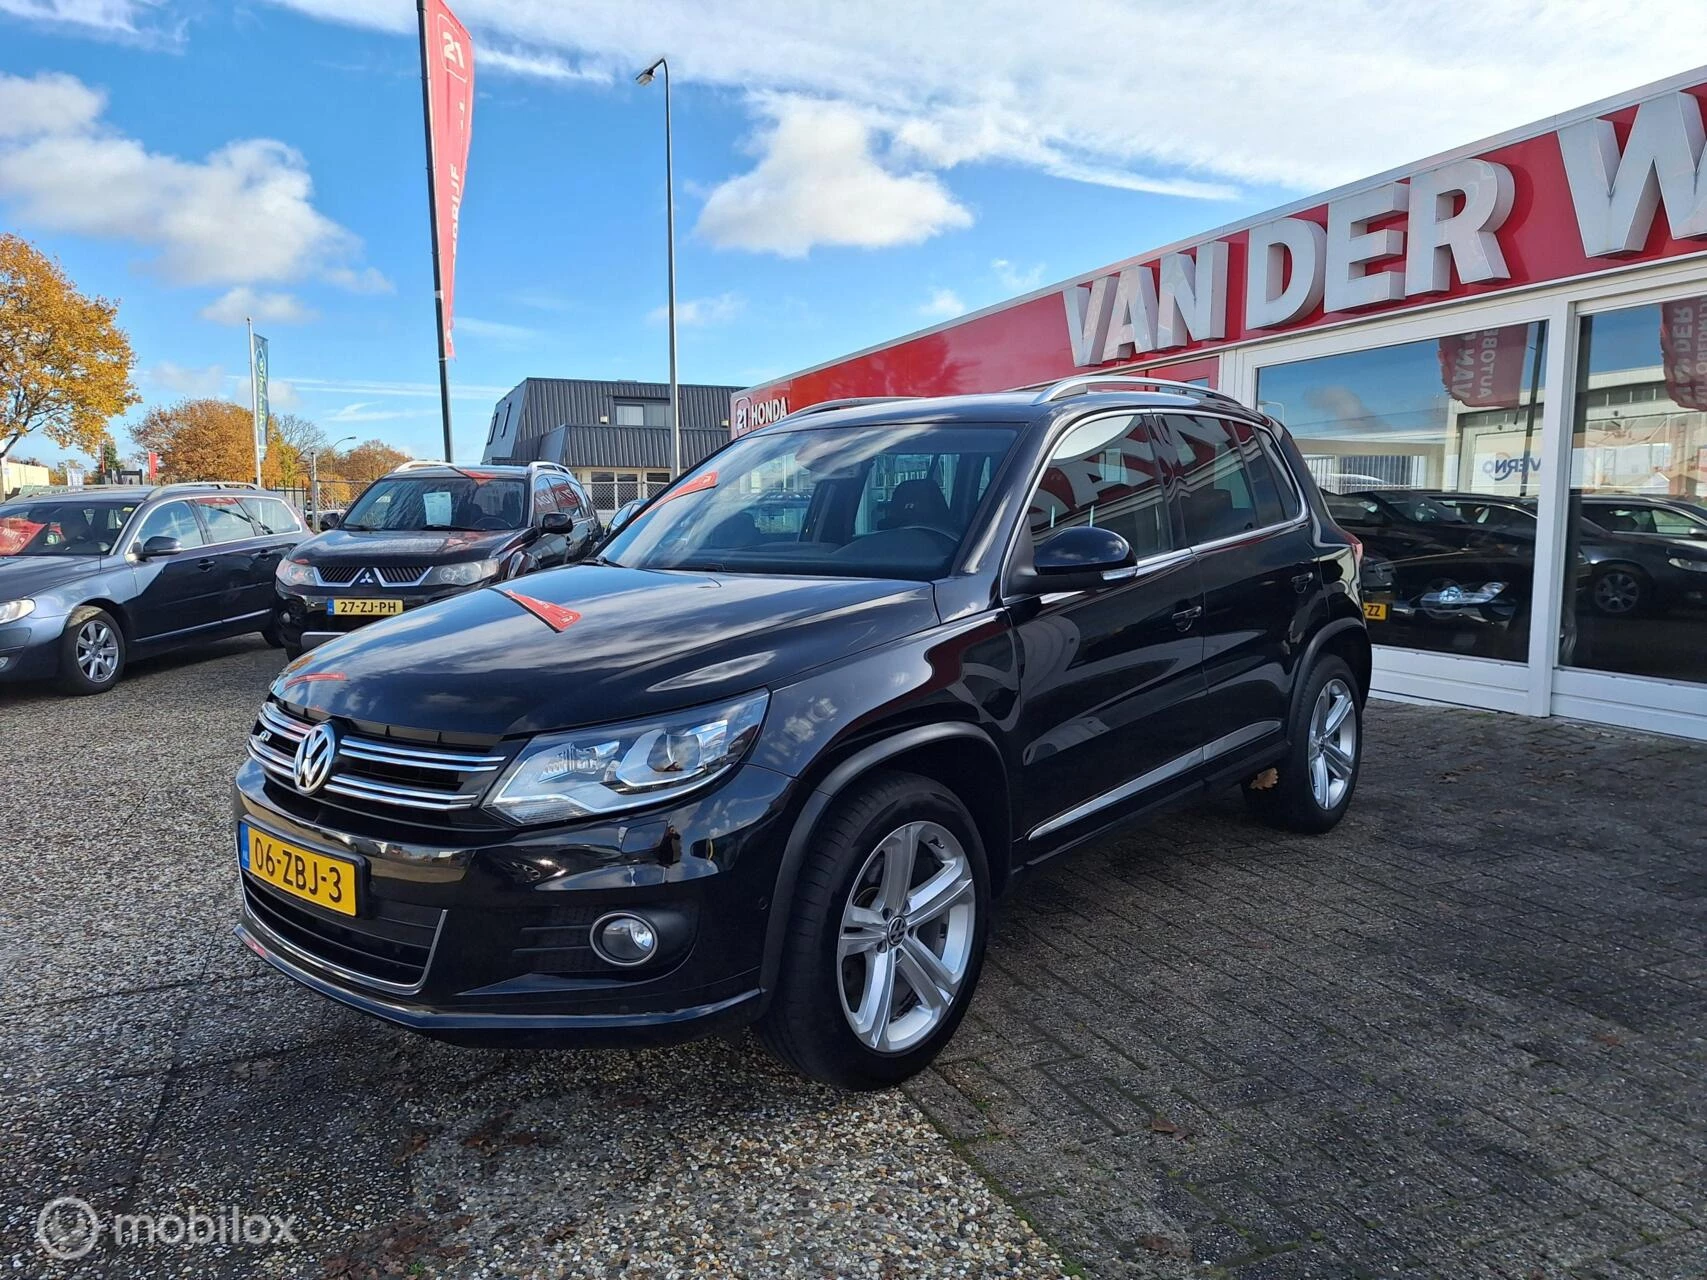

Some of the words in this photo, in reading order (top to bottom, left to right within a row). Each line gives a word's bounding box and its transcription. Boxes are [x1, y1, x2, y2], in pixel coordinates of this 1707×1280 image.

[442, 31, 464, 69] 21
[1063, 240, 1229, 367] VAN
[1246, 158, 1515, 330] DER
[736, 408, 748, 430] 21
[751, 397, 788, 426] HONDA
[340, 602, 396, 613] 27-ZJ-PH
[255, 837, 342, 903] 06-ZBJ-3
